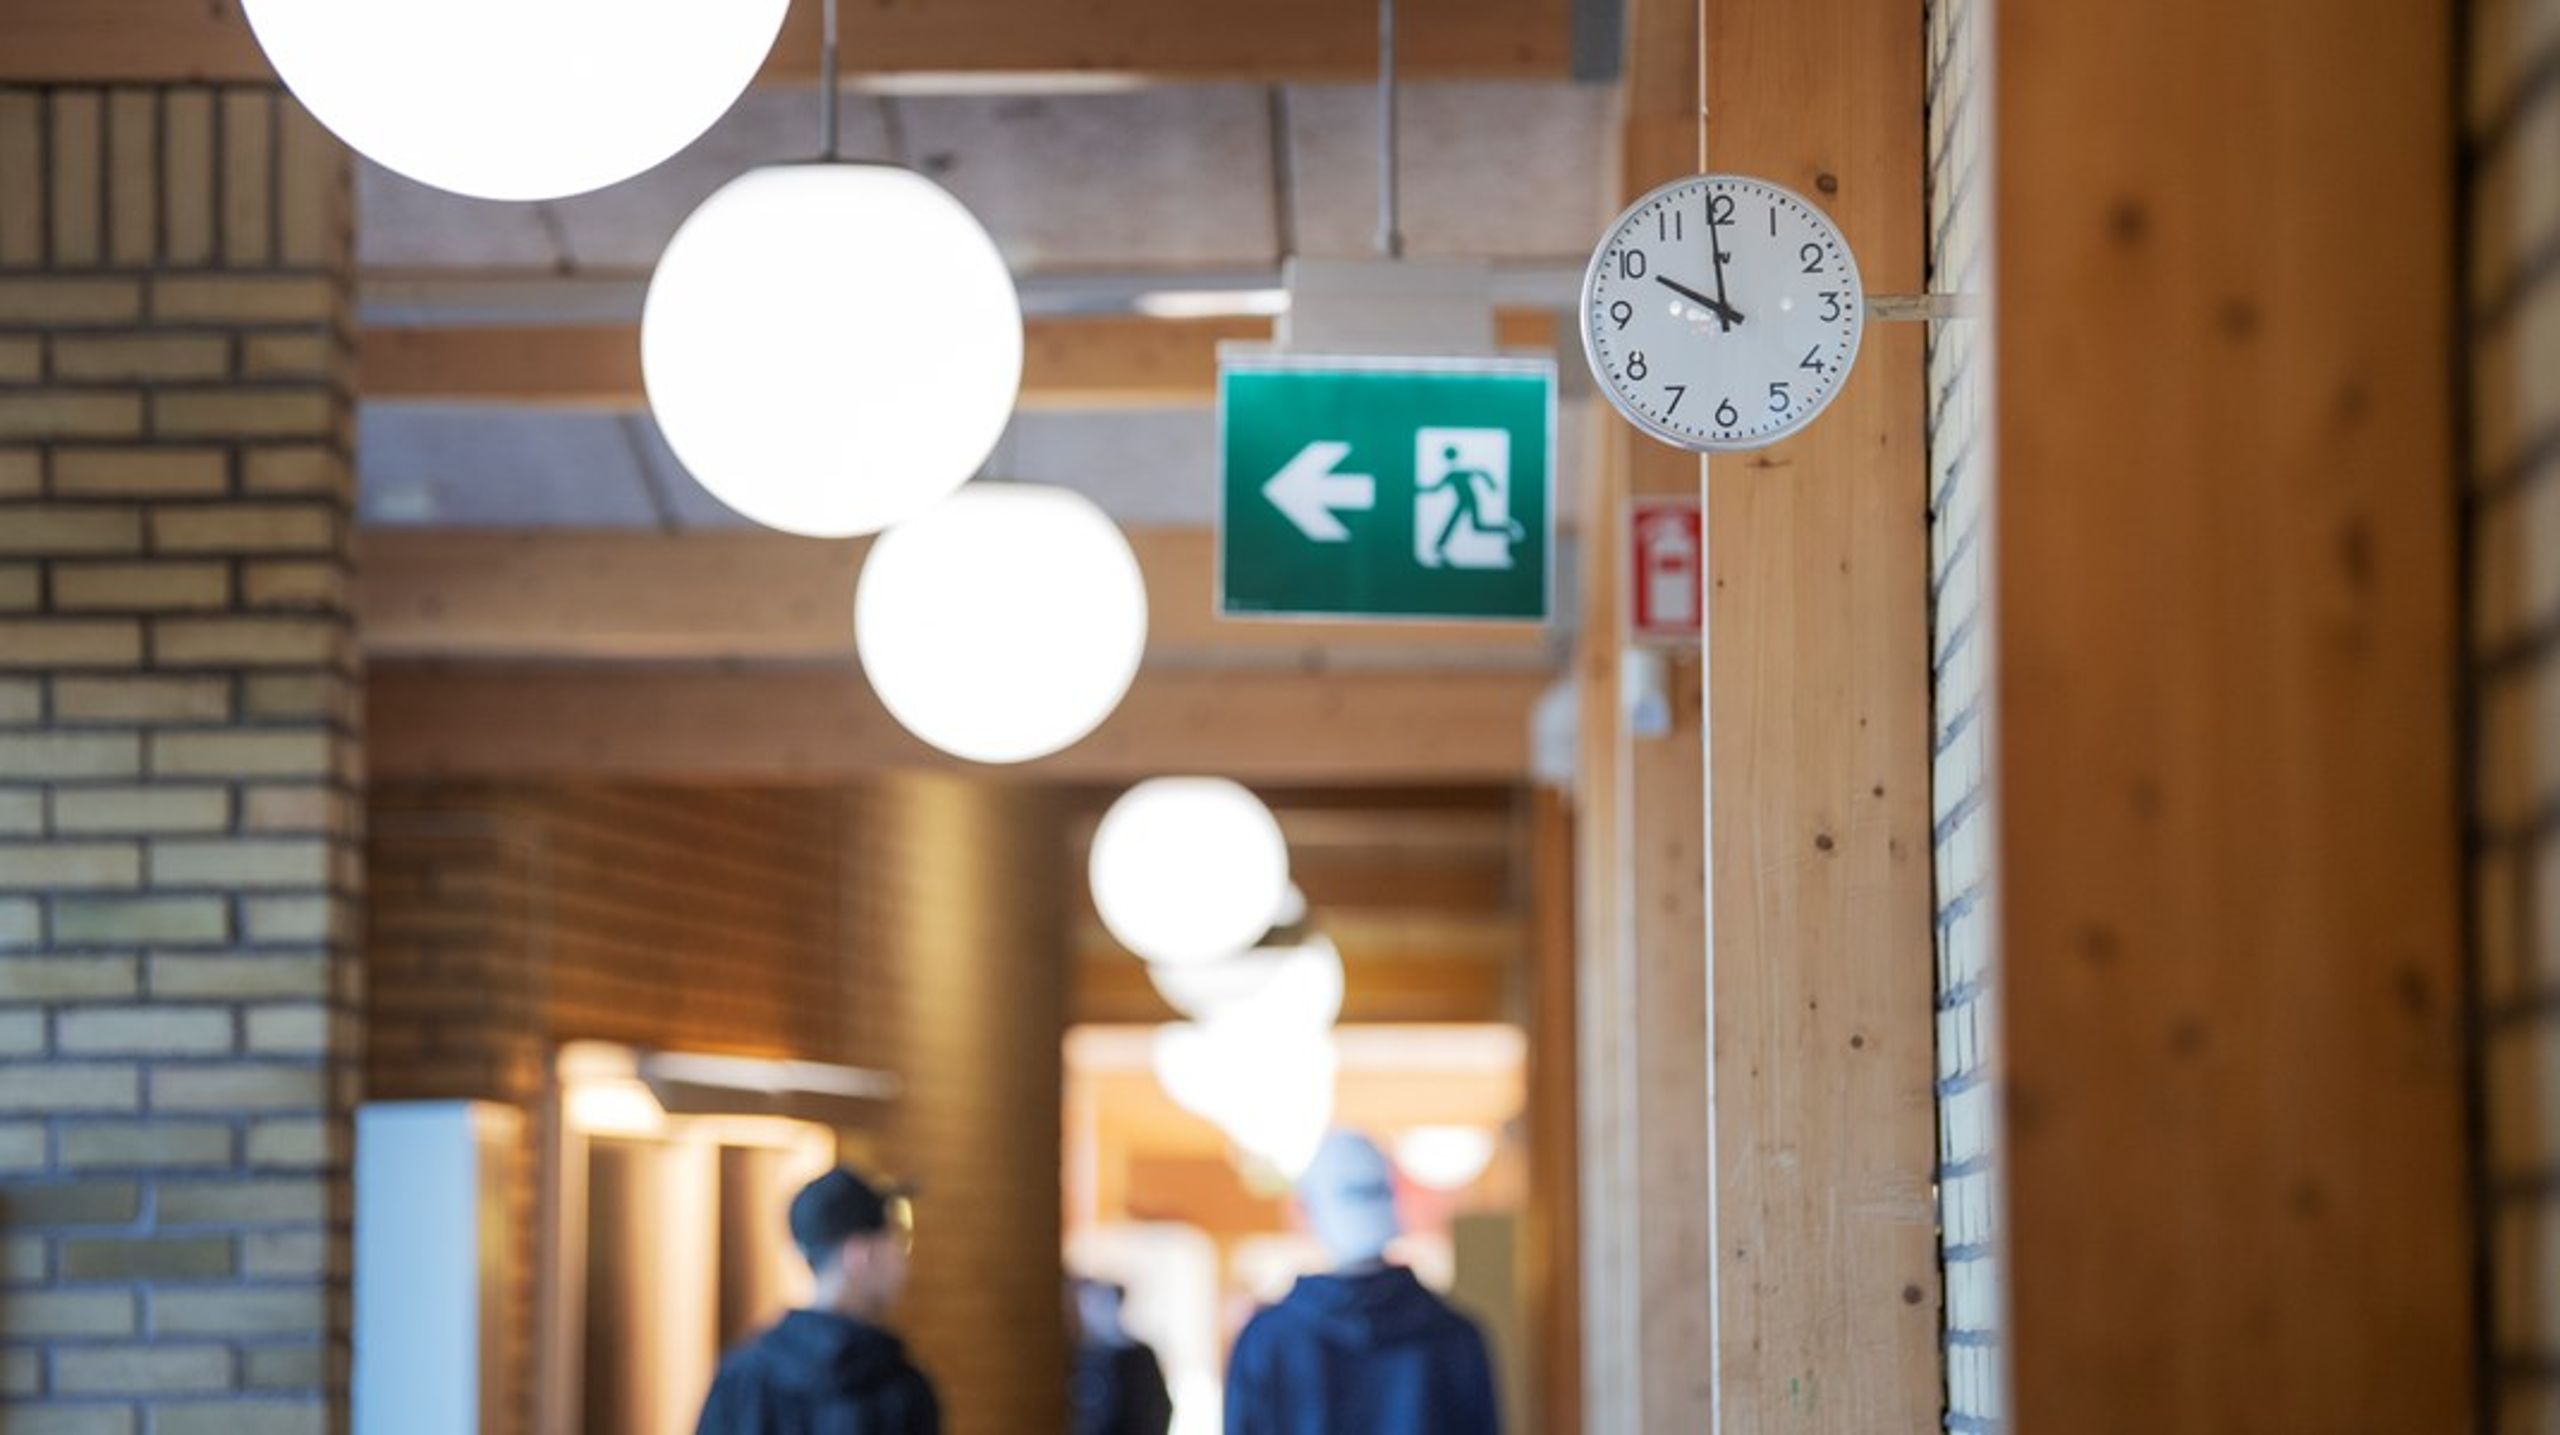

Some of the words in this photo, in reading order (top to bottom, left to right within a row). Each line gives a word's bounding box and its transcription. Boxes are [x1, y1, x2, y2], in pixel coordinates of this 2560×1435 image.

[1660, 211, 1681, 241] 11
[1770, 207, 1776, 236] 1
[1620, 249, 1646, 280] 10
[1800, 243, 1824, 273] 2
[1610, 301, 1632, 330] 9
[1819, 291, 1840, 322] 3
[1627, 350, 1647, 381] 8
[1799, 344, 1825, 374] 4
[1664, 386, 1686, 415] 7
[1715, 397, 1738, 427] 6
[1769, 382, 1789, 412] 5
